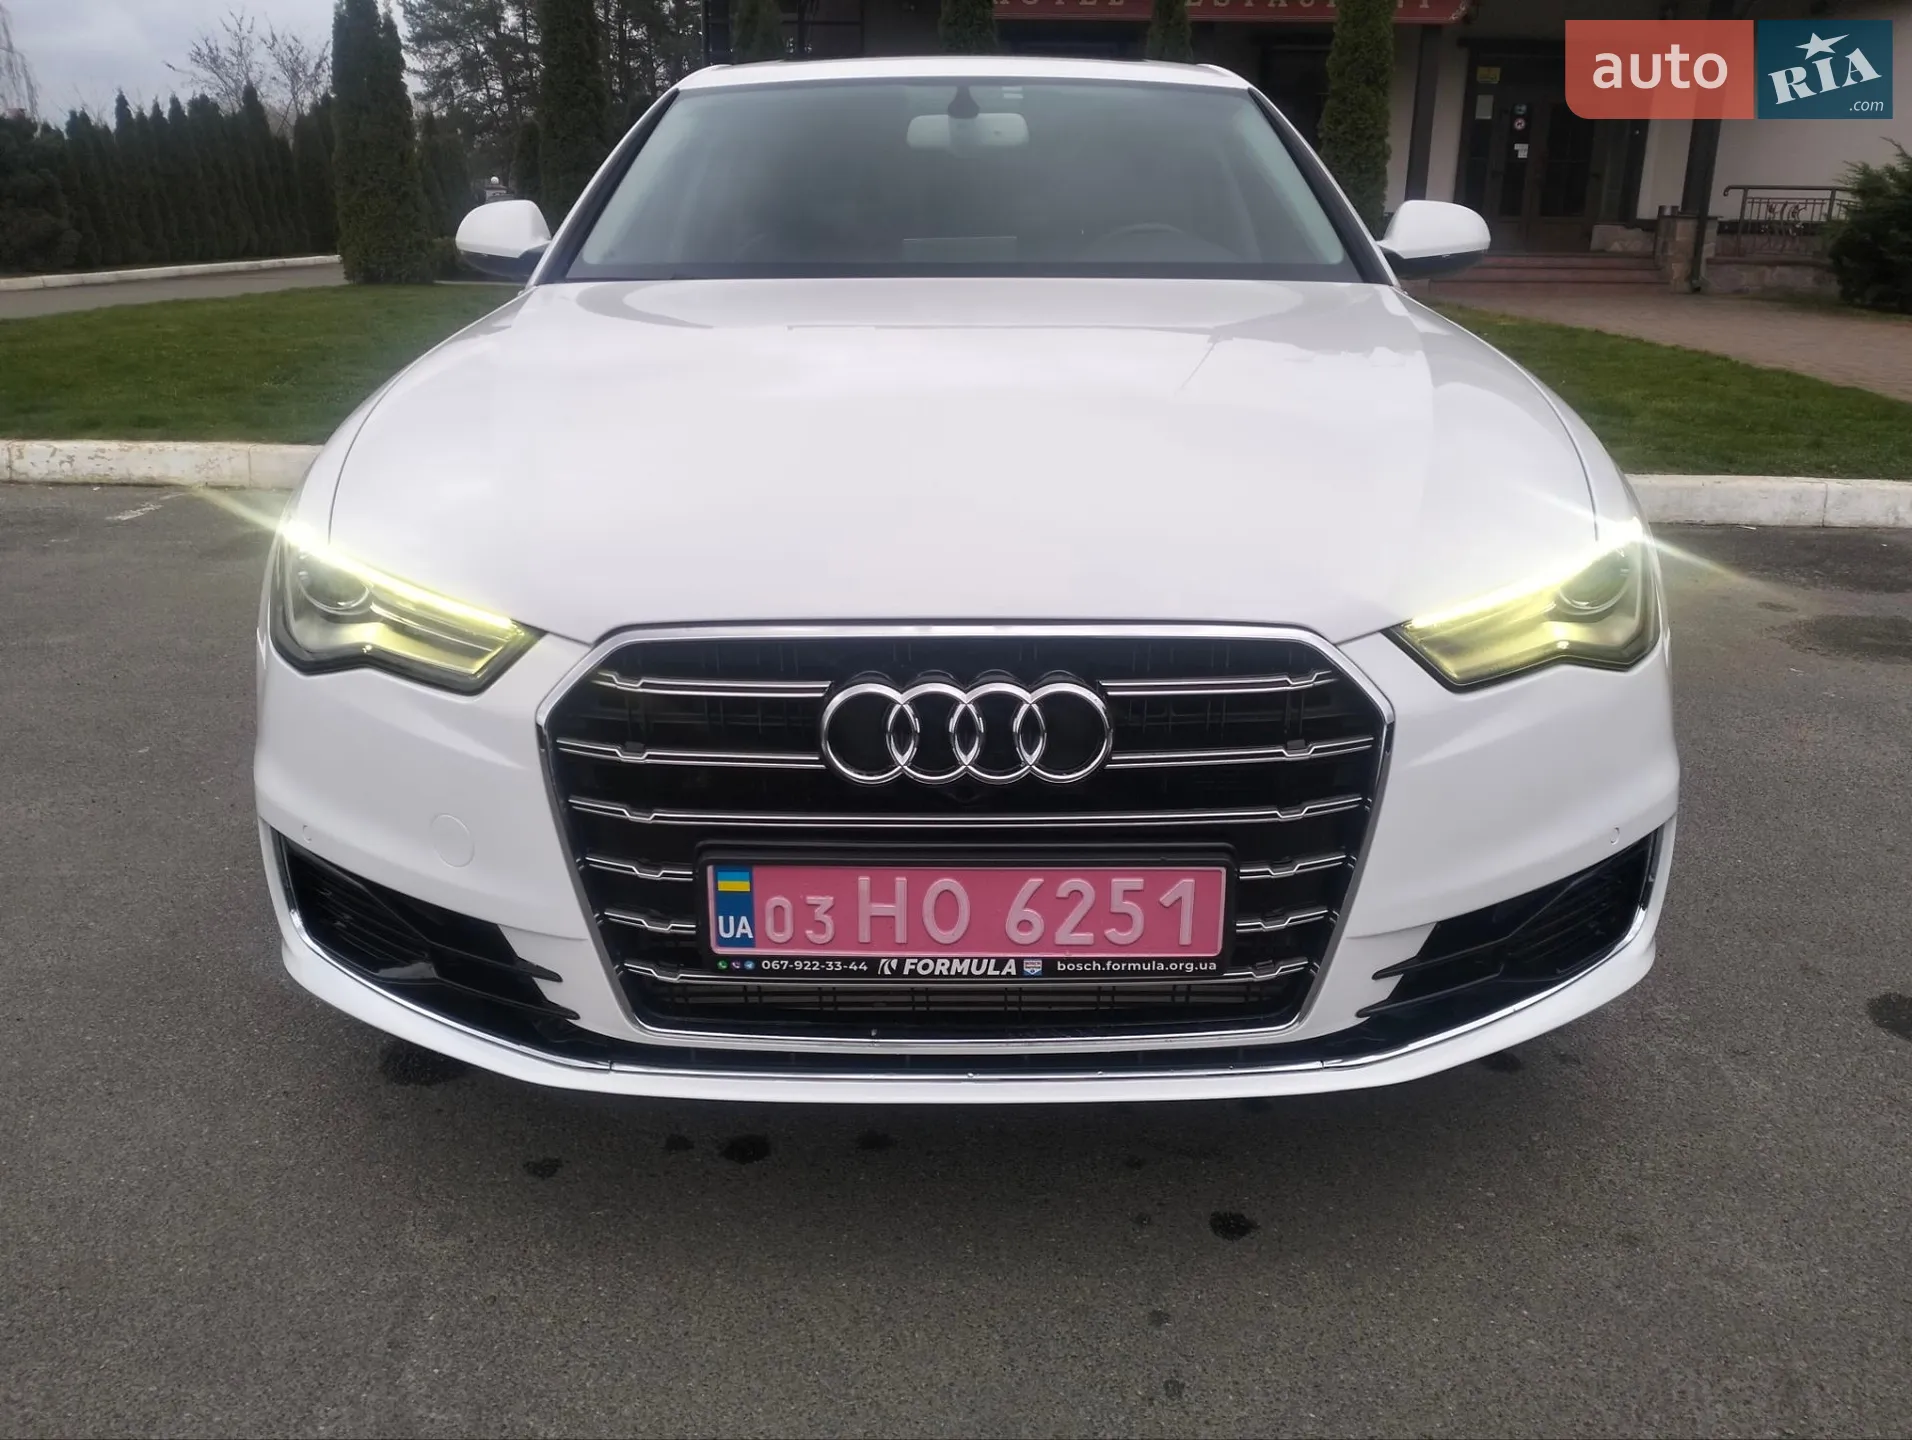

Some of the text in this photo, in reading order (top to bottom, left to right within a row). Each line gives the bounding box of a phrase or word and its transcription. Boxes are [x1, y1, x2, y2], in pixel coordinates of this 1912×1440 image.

[765, 876, 1195, 946] 03 HO 6251
[718, 916, 753, 938] UA
[761, 960, 868, 971] 067-922-33-44
[903, 959, 1017, 975] FORMULA
[1057, 961, 1217, 972] bosch.formula.org.ua
